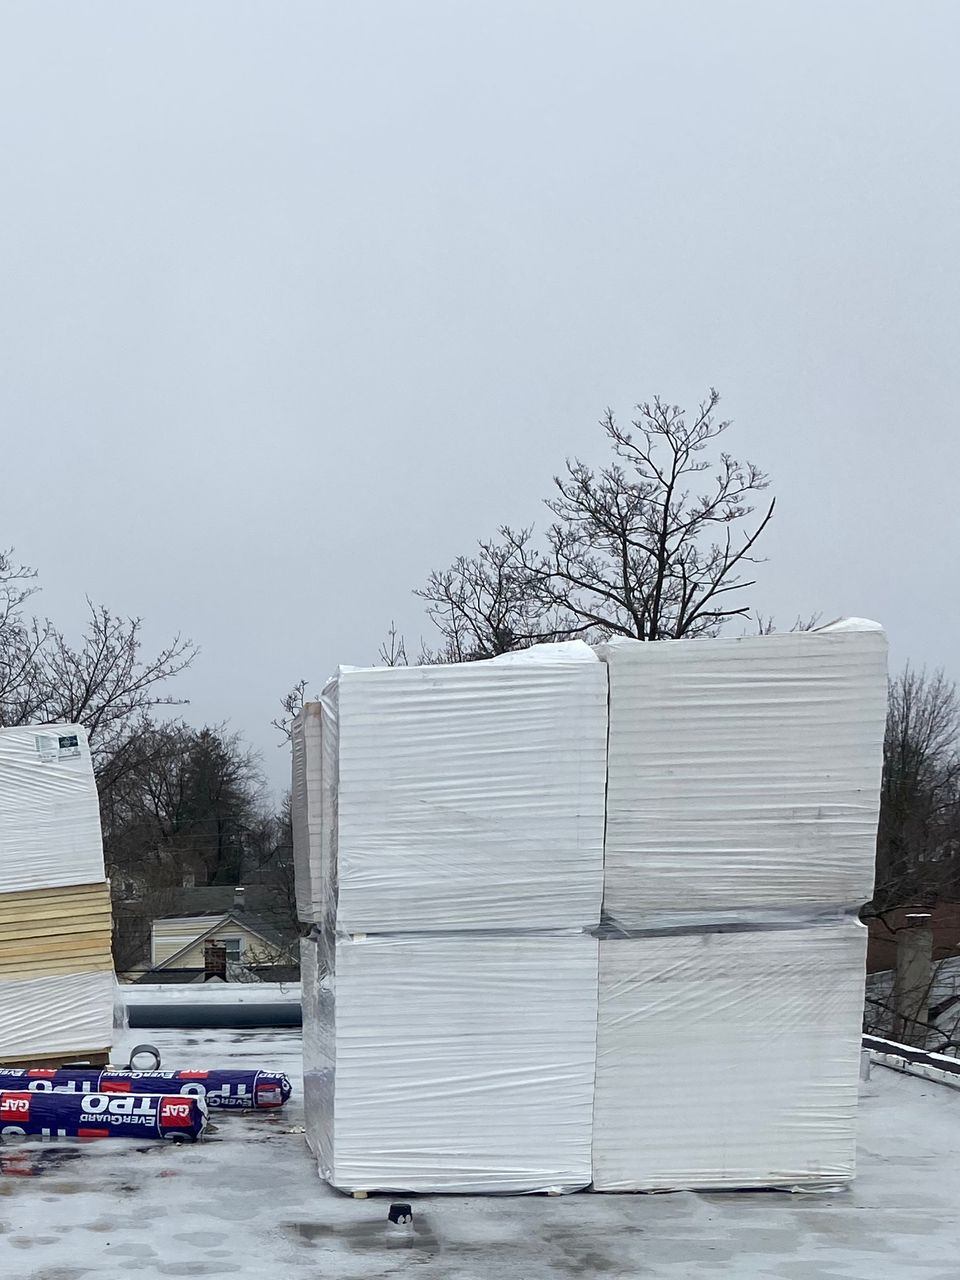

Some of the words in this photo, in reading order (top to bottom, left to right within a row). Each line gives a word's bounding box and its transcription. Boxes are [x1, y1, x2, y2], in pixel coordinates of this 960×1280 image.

[0, 1100, 30, 1112] GAF
[81, 1095, 157, 1115] TPO
[161, 1104, 190, 1117] GAF
[80, 1114, 156, 1126] EVERGUARD
